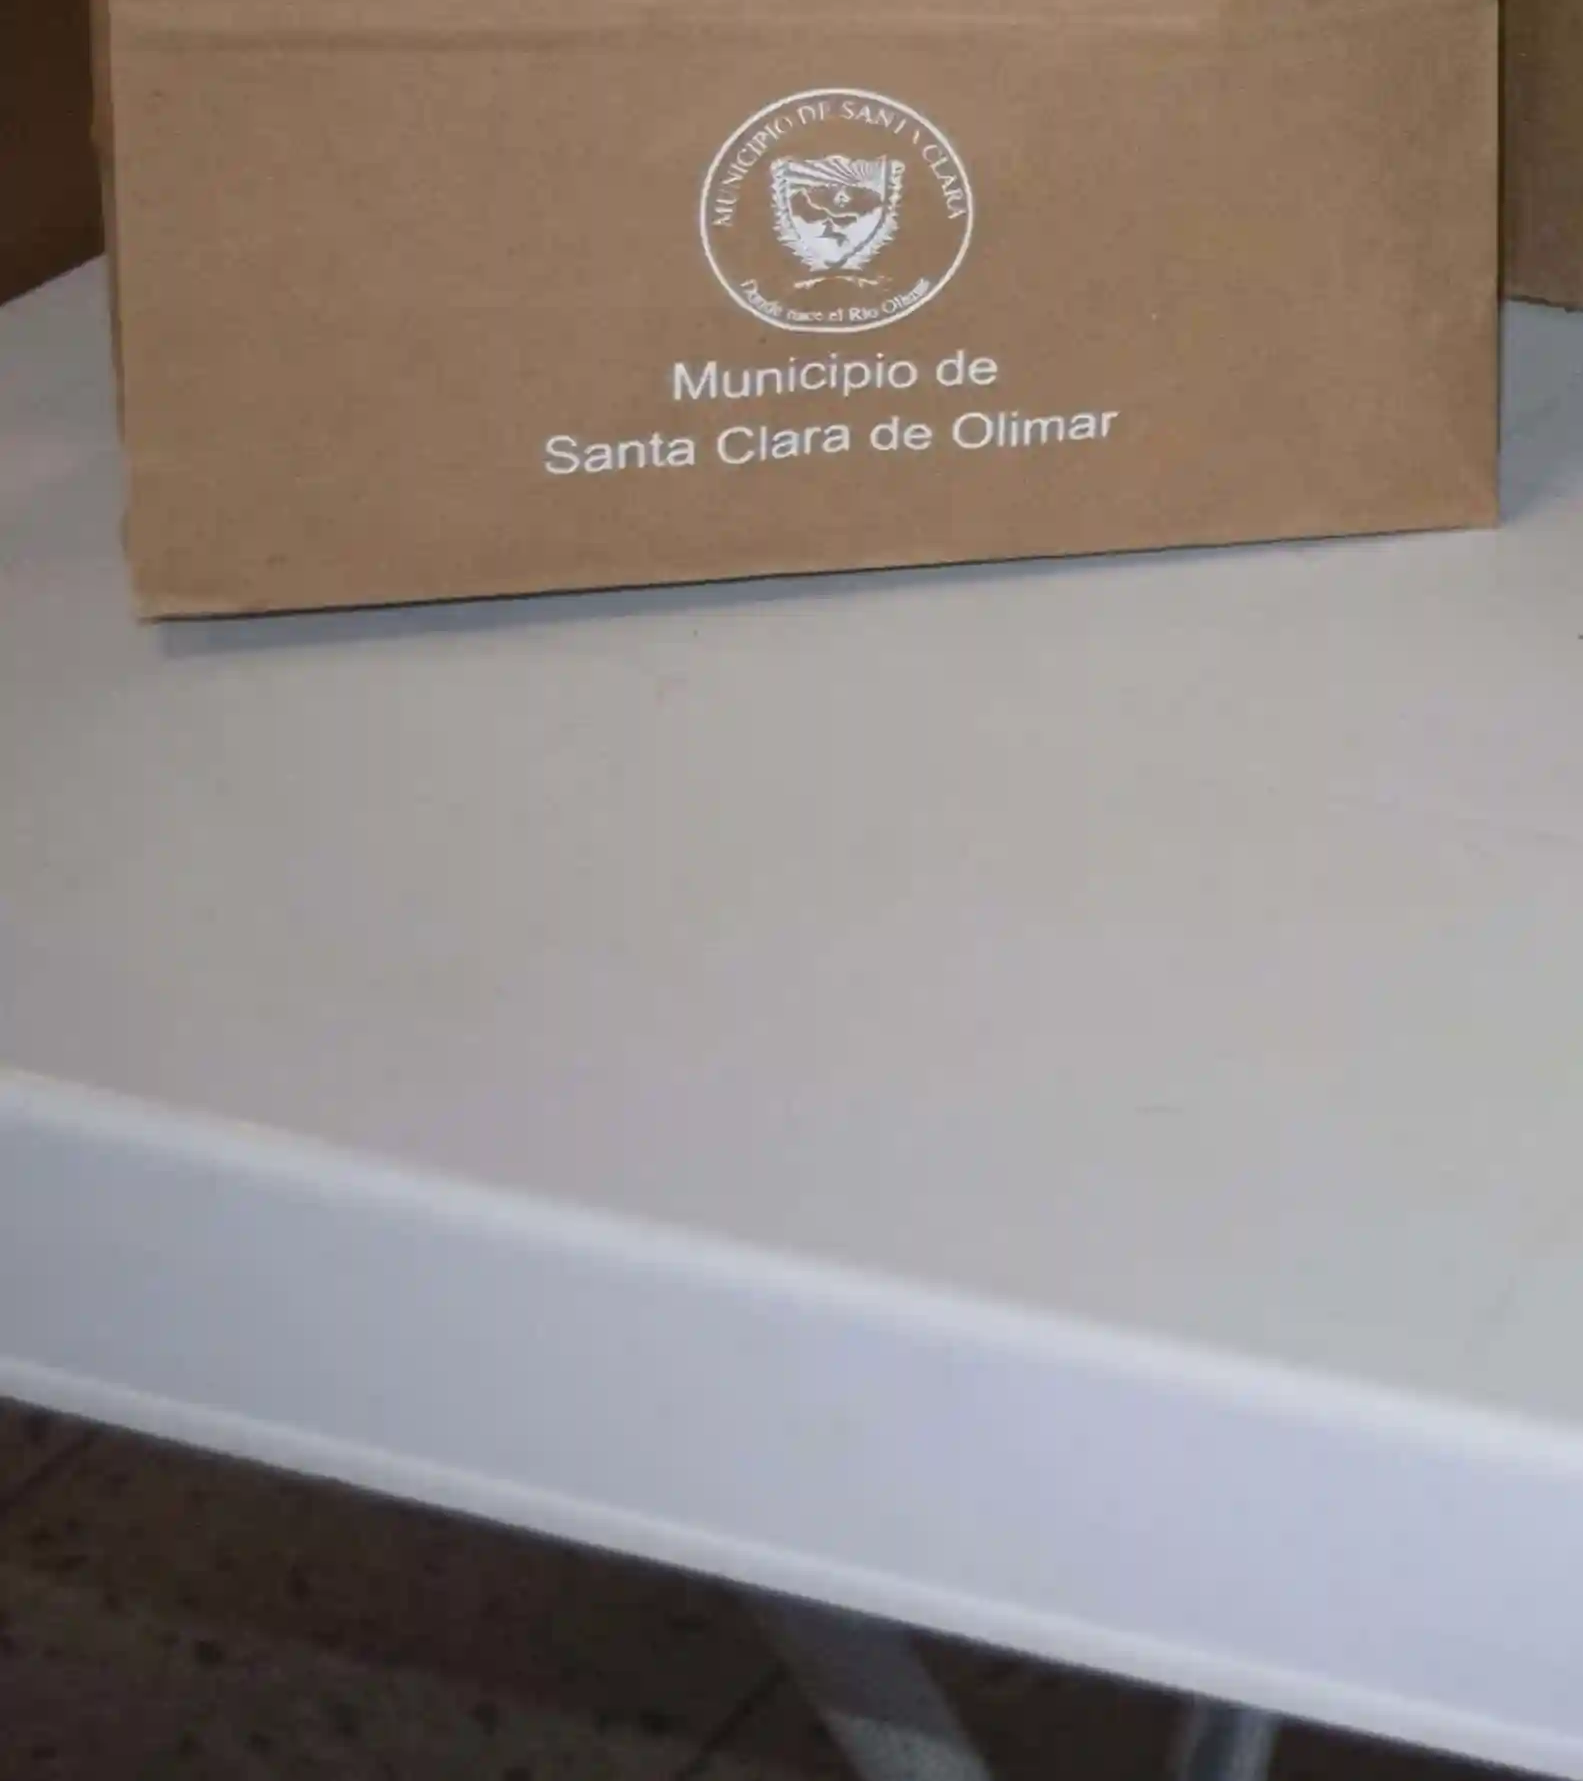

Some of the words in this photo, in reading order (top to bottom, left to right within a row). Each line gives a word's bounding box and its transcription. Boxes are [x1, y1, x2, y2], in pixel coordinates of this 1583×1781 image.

[711, 116, 795, 228] MUNICIPIO
[921, 144, 968, 220] CLARA
[672, 353, 919, 402] Municipio
[934, 350, 999, 387] de
[543, 433, 696, 475] Santa
[716, 418, 851, 466] Clara
[868, 416, 934, 452] de
[952, 408, 1120, 451] Olimar
